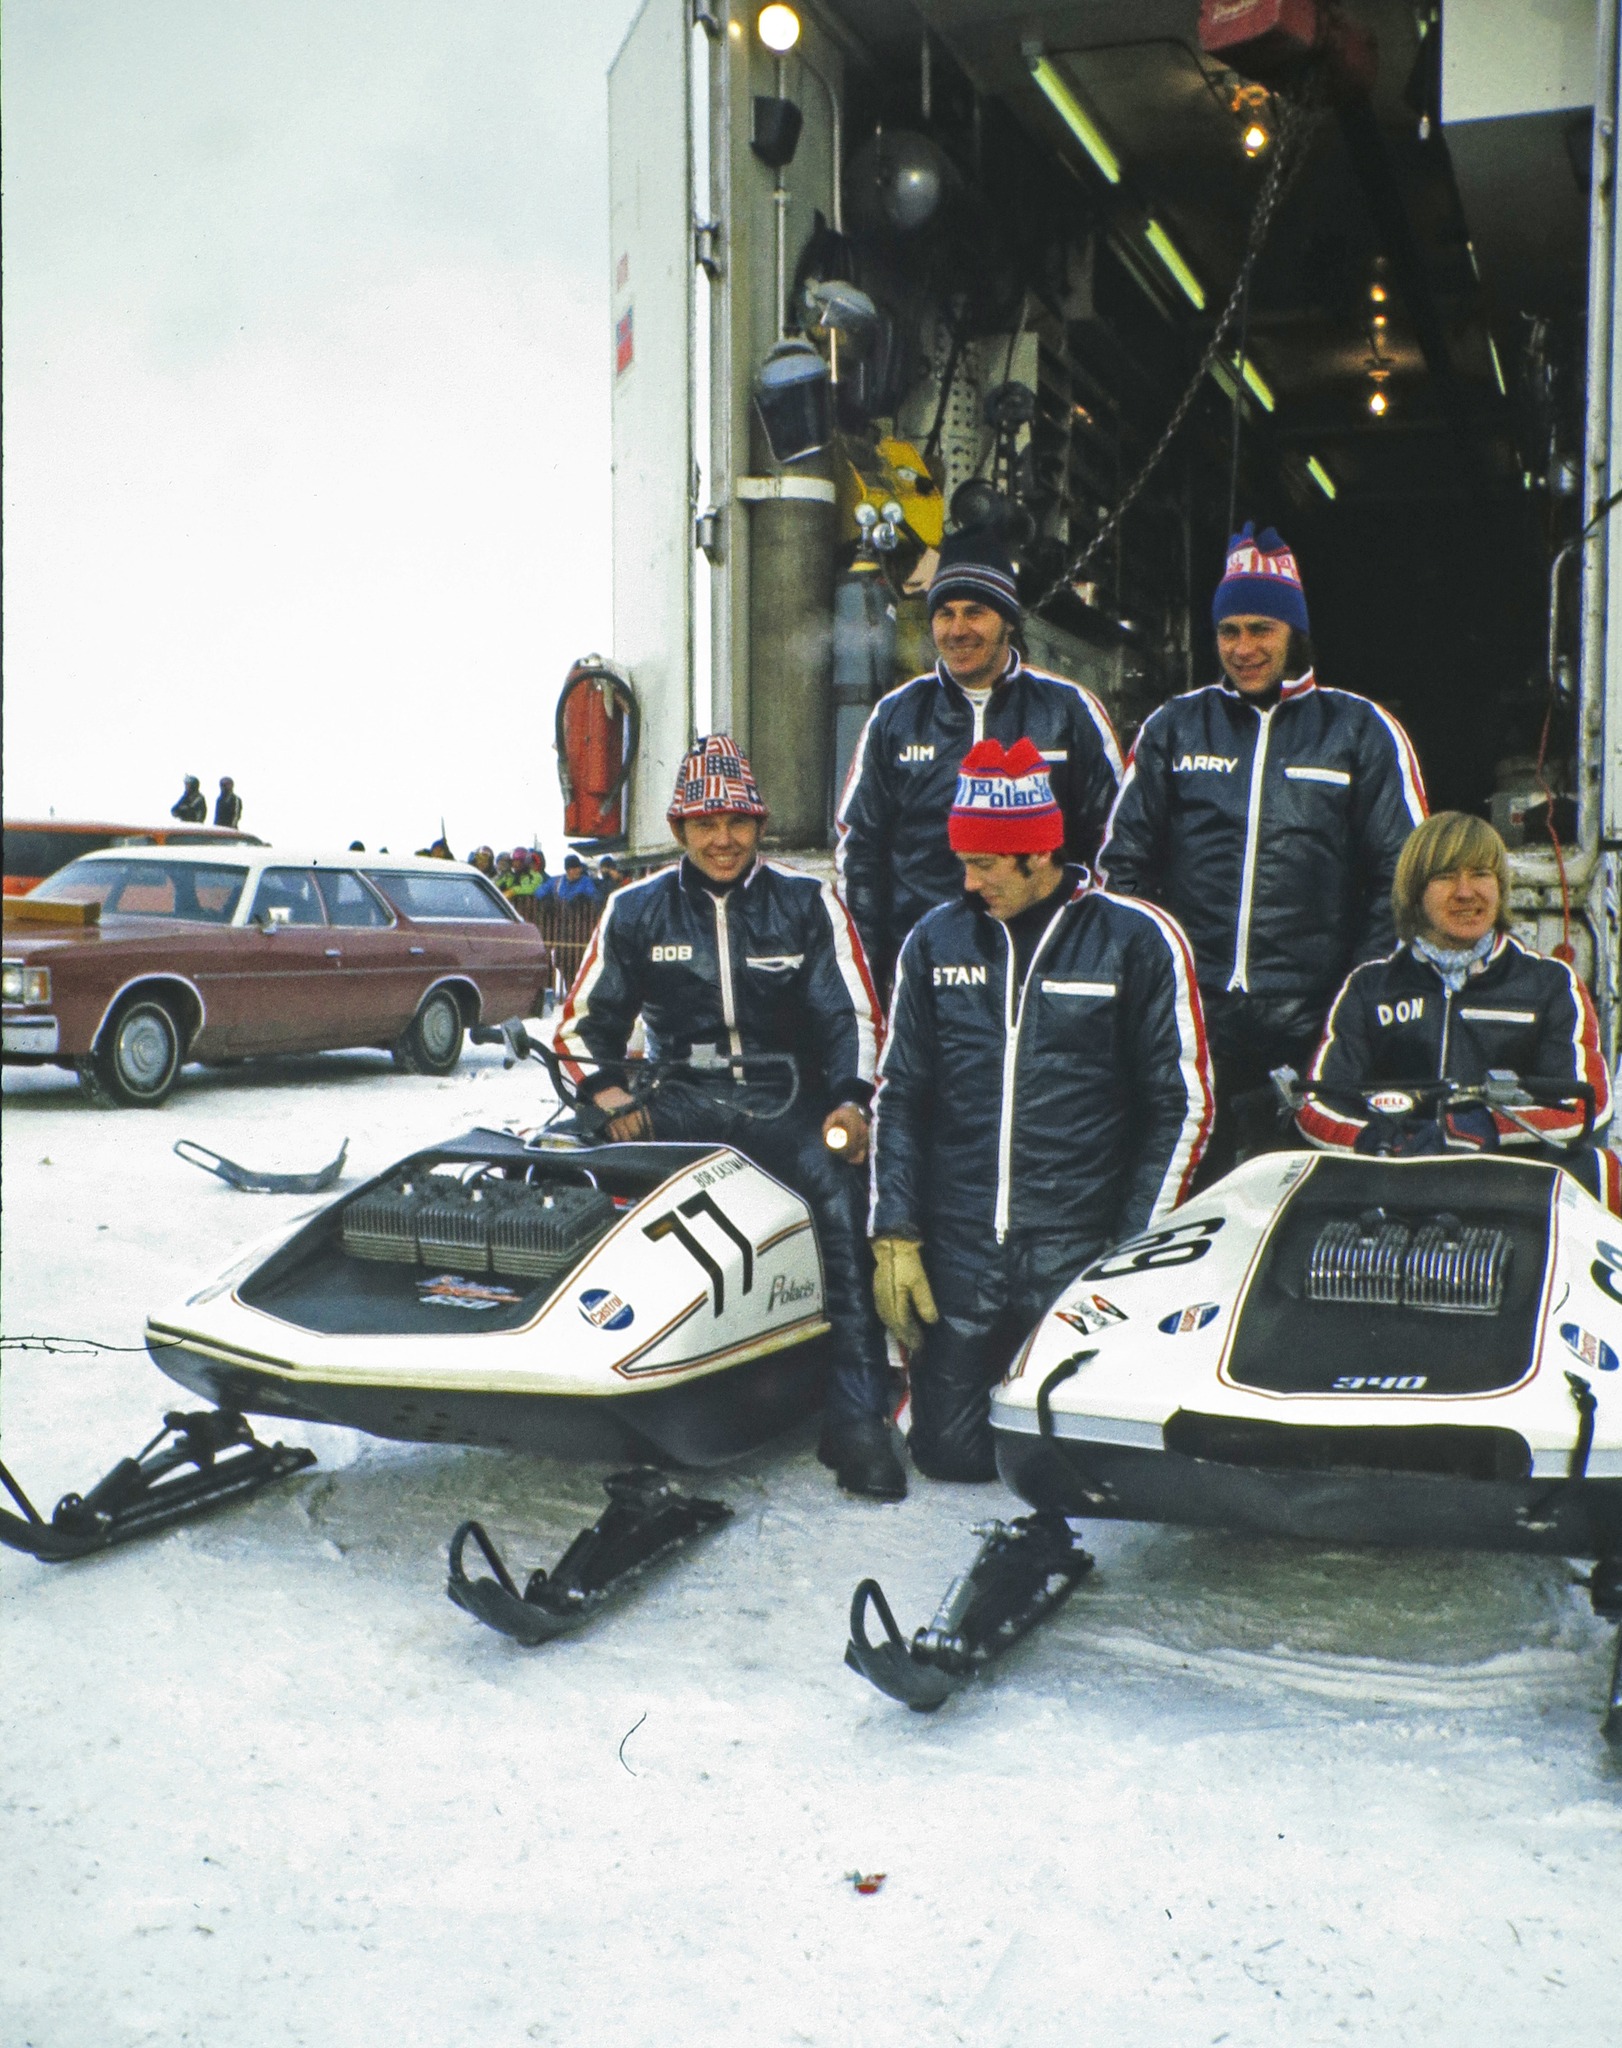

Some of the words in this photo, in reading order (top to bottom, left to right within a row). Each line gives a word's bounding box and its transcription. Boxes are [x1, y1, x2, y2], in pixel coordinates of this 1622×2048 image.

[899, 745, 935, 762] JIM
[1173, 755, 1239, 773] LARRY
[651, 945, 692, 962] BOB
[933, 966, 986, 986] STAN
[1377, 997, 1424, 1026] DON
[642, 1190, 753, 1318] 77
[590, 1293, 623, 1325] Castrol
[1332, 1376, 1428, 1389] 340
